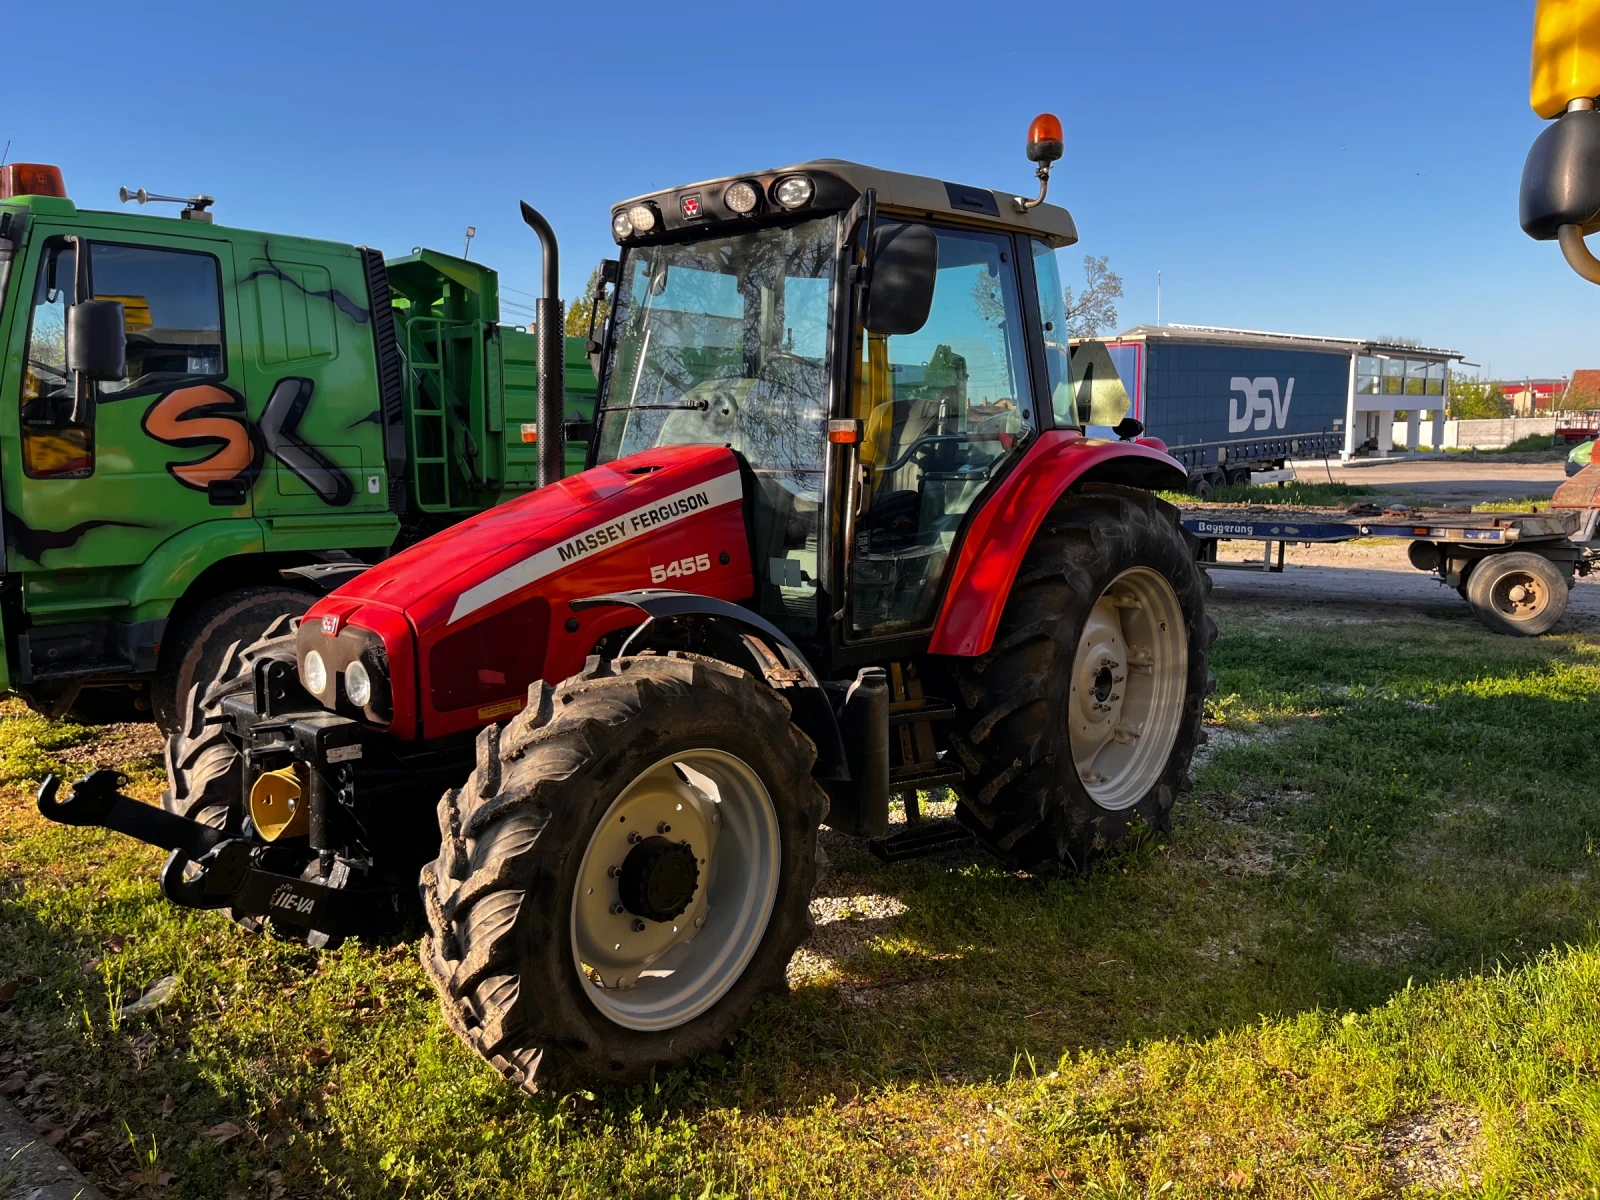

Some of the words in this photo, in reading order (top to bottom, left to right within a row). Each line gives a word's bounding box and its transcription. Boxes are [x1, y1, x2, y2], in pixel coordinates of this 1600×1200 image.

[1229, 377, 1295, 433] DSV
[557, 521, 627, 562] MASSEY
[631, 492, 709, 531] FERGUSON
[1198, 522, 1253, 535] Baggerung
[650, 553, 711, 584] 5455
